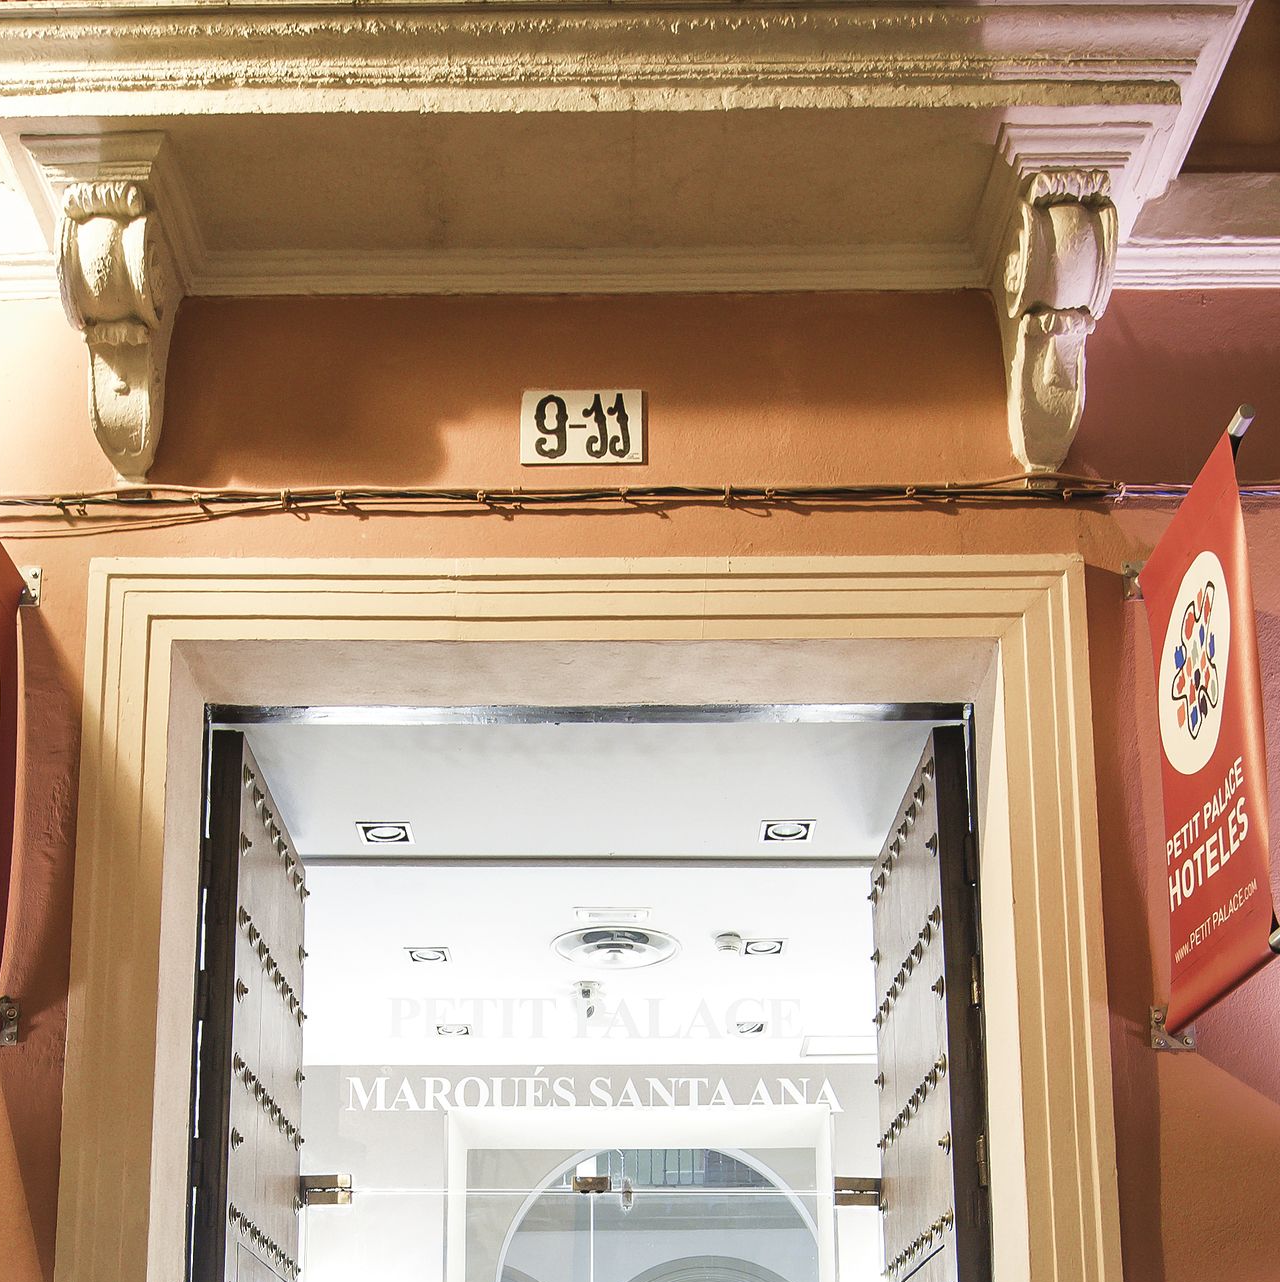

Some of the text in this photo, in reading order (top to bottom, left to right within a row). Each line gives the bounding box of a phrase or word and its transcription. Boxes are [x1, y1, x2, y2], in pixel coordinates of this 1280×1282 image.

[534, 393, 631, 459] 9-11
[1166, 756, 1244, 866] PETIT PALACE
[1168, 797, 1249, 913] HOTELES
[387, 996, 557, 1040] PETIT
[345, 1066, 844, 1113] MARQUÉS SANTA ANA
